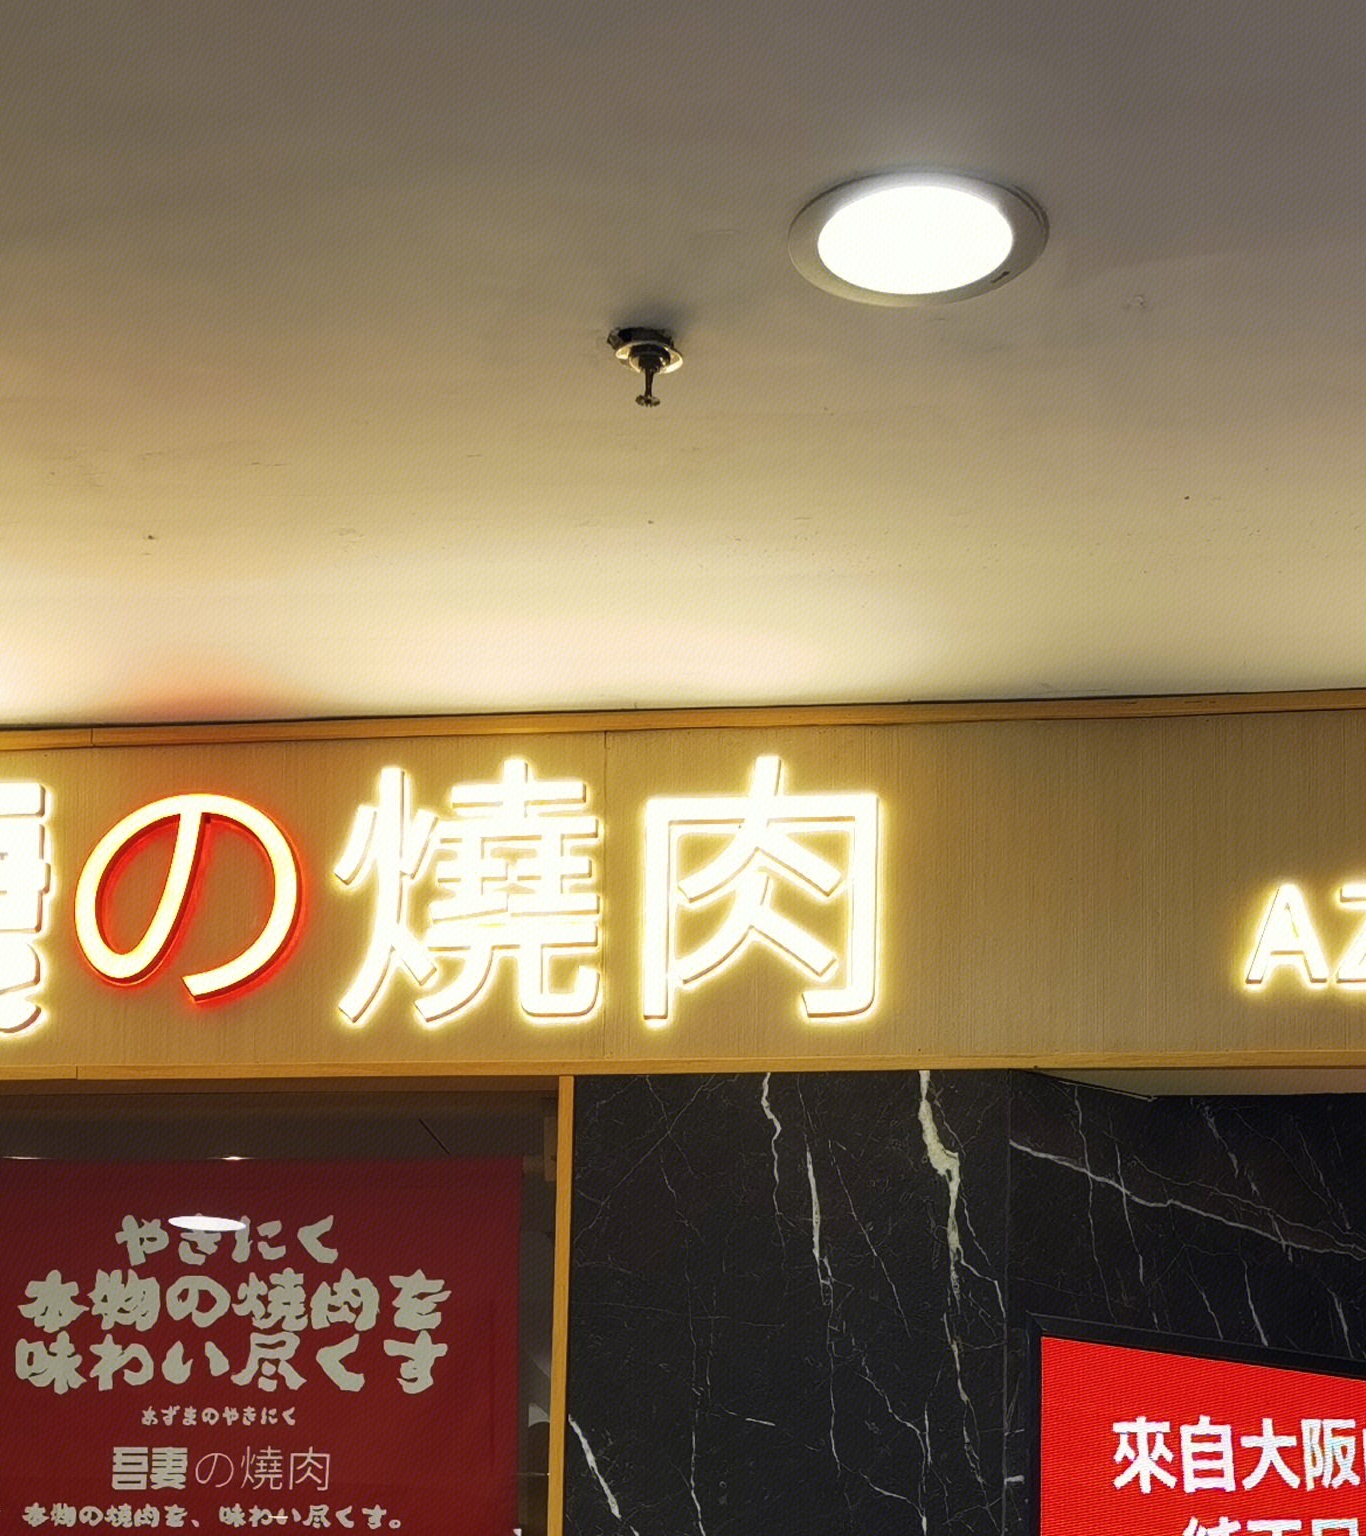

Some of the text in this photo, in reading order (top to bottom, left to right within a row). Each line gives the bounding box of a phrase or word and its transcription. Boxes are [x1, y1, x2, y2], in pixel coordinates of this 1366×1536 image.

[115, 1213, 338, 1266] やきにく
[14, 1331, 448, 1394] 味わい尽くす
[110, 1445, 332, 1492] 吾妻の燒肉
